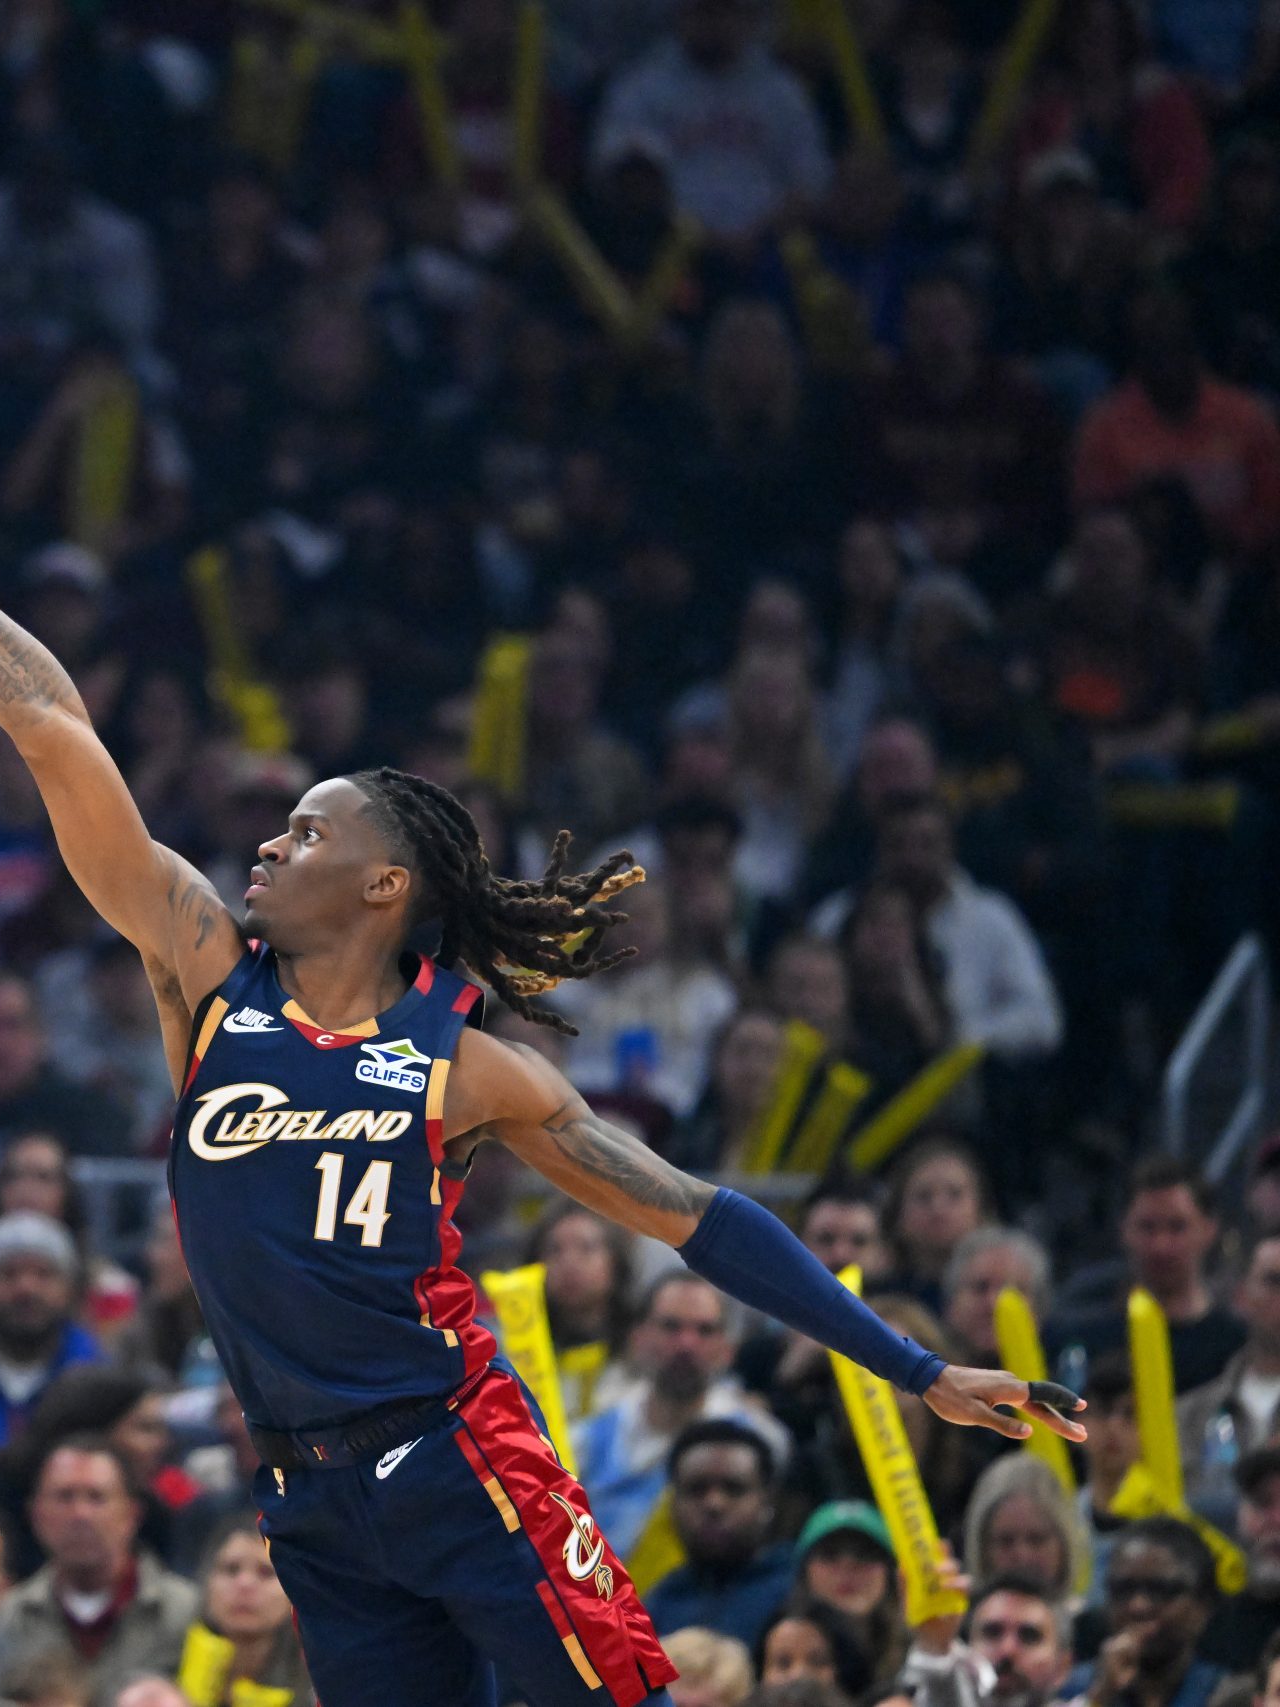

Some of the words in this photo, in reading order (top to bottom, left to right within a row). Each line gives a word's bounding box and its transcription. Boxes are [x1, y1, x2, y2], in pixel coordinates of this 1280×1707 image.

[234, 1006, 275, 1028] NIKE
[358, 1063, 424, 1089] CLIFFS
[188, 1082, 413, 1162] CLEVELAND
[314, 1151, 392, 1248] 14
